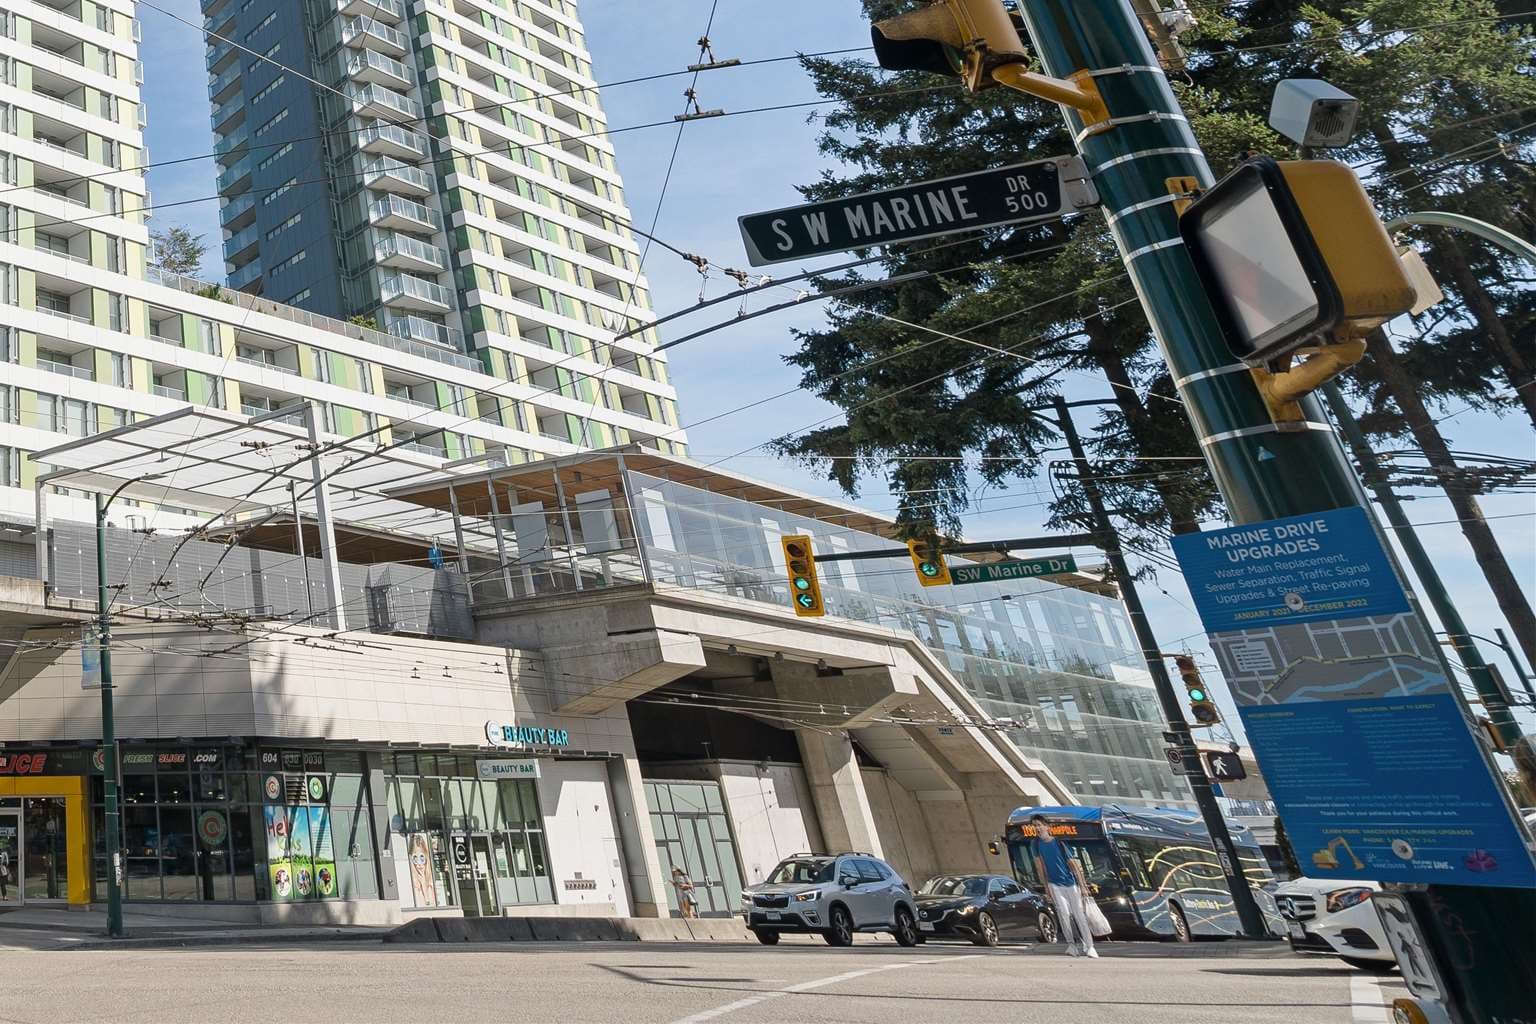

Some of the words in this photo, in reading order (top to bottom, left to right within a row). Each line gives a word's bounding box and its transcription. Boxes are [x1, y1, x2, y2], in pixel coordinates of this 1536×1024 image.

[1006, 174, 1031, 193] DR
[1004, 191, 1049, 214] 500
[771, 218, 793, 252] S
[802, 211, 831, 246] W
[843, 185, 979, 240] MARINE
[1206, 528, 1272, 549] MARINE
[1274, 519, 1329, 539] DRIVE
[1226, 538, 1321, 563] UPGRADES
[956, 568, 981, 582] SW
[987, 563, 1043, 578] Marine
[1048, 559, 1068, 572] Dr
[1214, 567, 1245, 579] Water
[1247, 564, 1273, 575] Main
[1274, 553, 1349, 571] Replacement,
[1205, 582, 1236, 593] Sewer
[1238, 573, 1297, 589] Separation,
[1299, 567, 1334, 581] Traffic
[1335, 563, 1371, 578] Signal
[1216, 591, 1265, 605] Upgrades
[1267, 588, 1276, 598] &
[1276, 583, 1311, 596] Street
[1312, 577, 1371, 593] Re-paving
[1234, 609, 1270, 621] JANUARY
[1299, 601, 1345, 613] DECEMBER
[502, 725, 546, 744] BEAUTY
[547, 728, 569, 746] BAR
[193, 754, 217, 763] .COM
[262, 752, 278, 763] 604
[492, 765, 519, 773] BEAUTY
[519, 764, 535, 773] BAR
